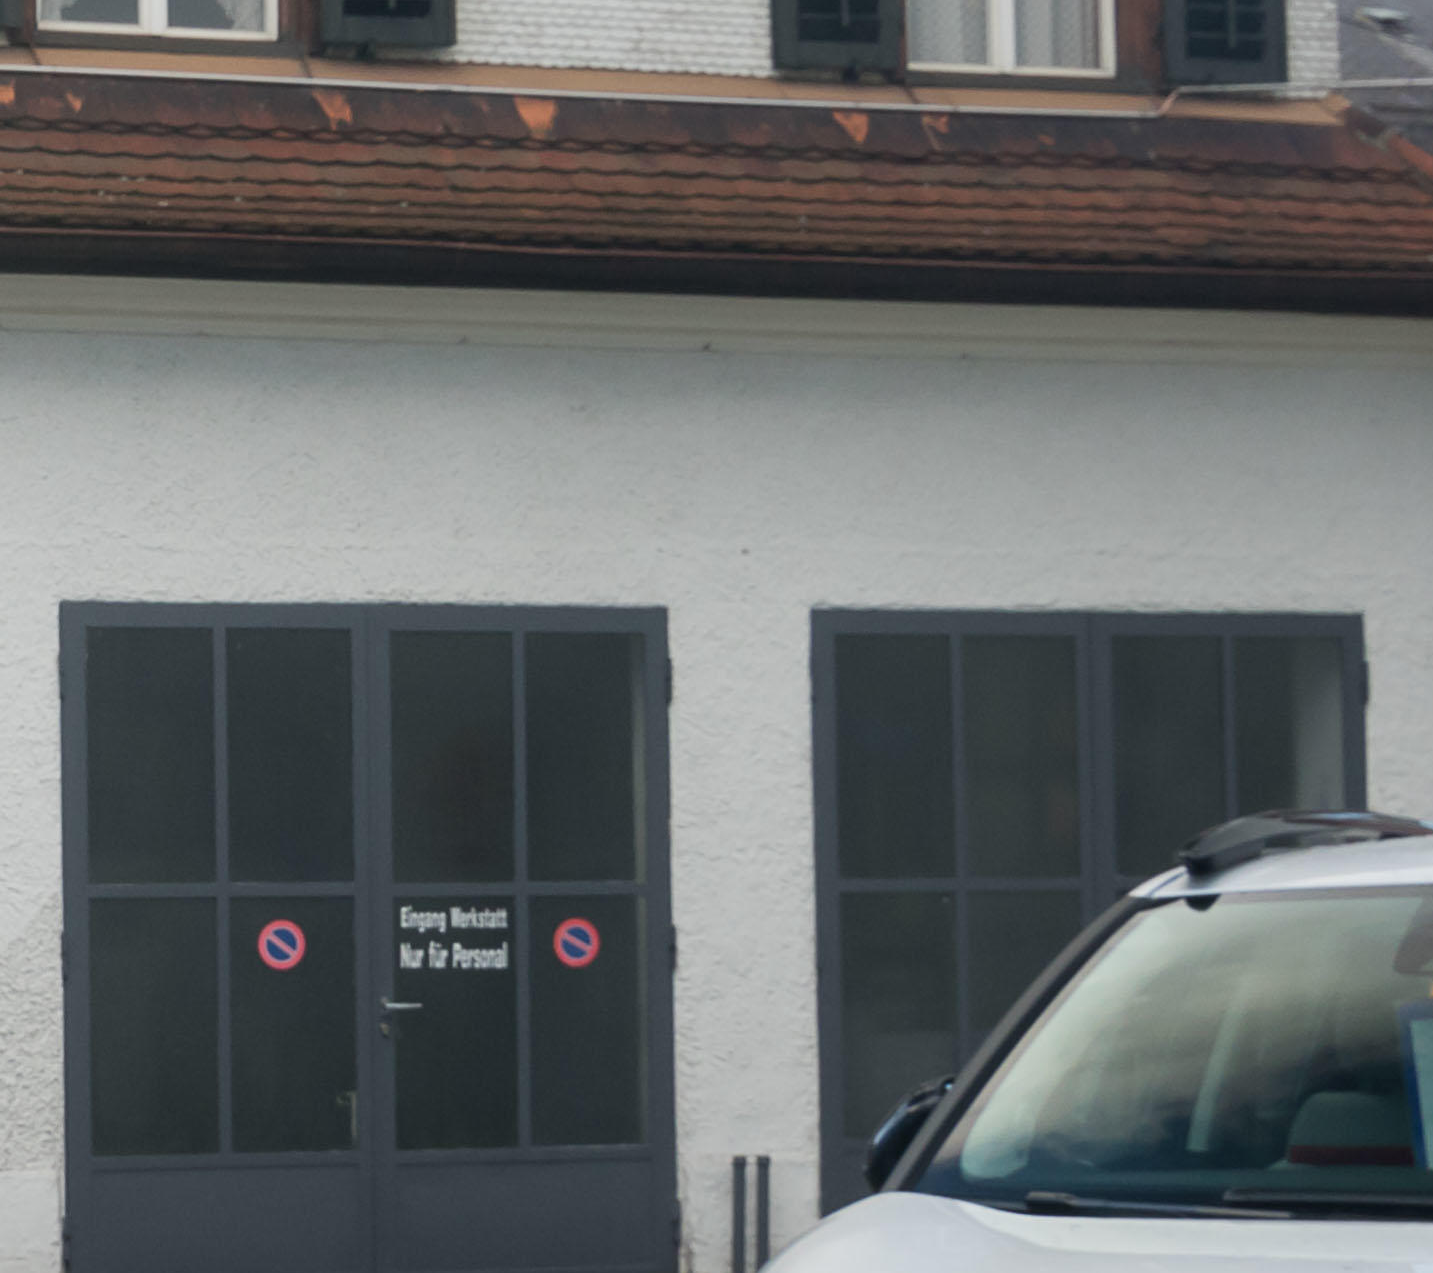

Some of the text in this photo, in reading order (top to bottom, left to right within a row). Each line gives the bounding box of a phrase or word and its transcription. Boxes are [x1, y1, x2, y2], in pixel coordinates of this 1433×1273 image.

[400, 905, 509, 933] Eingang Werkstatt
[399, 939, 509, 969] Nur für Personal
